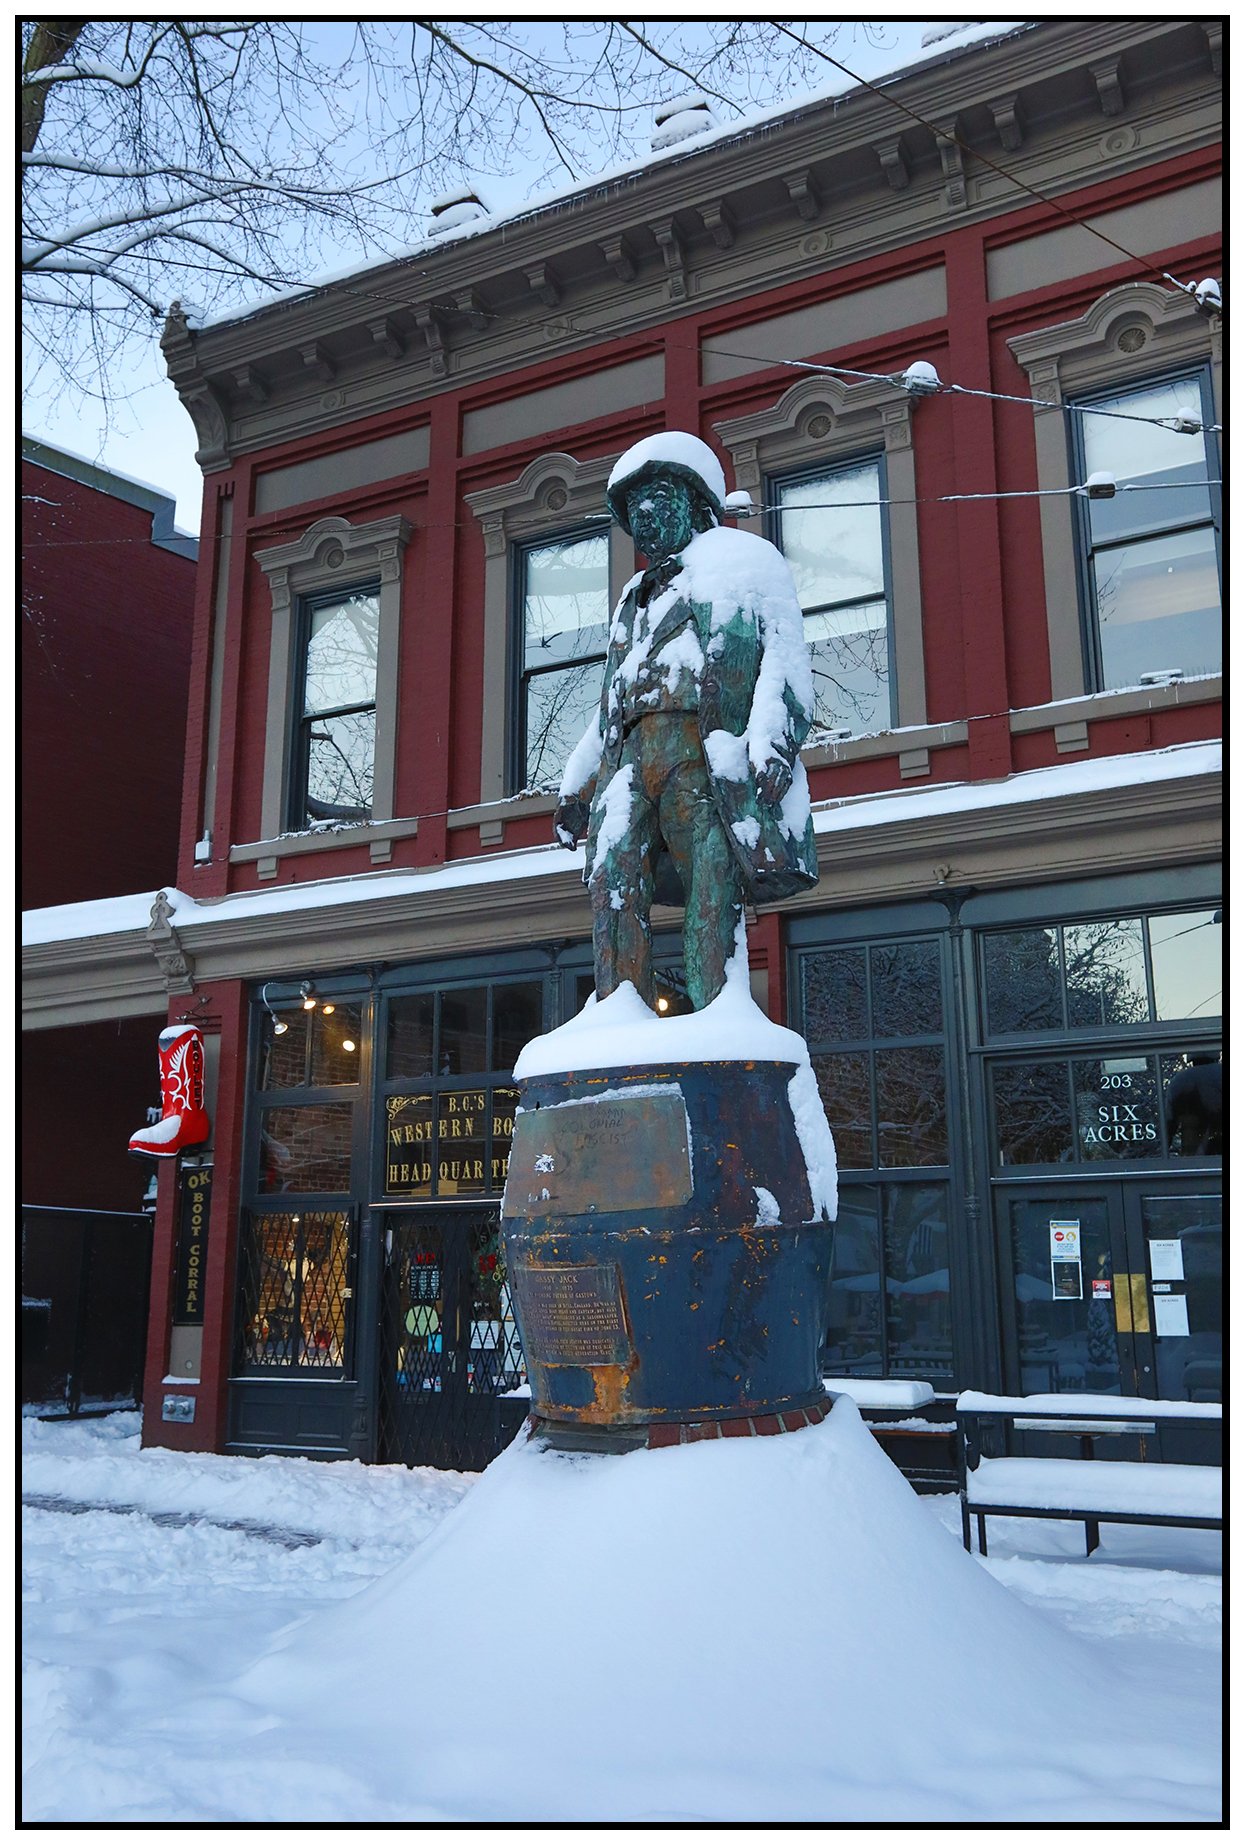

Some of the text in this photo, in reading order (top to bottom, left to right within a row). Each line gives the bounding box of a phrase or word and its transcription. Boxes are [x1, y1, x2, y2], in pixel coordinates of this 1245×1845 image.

[1100, 1074, 1132, 1089] 203
[1098, 1104, 1139, 1122] SIX
[390, 1117, 513, 1148] WESTERN BO
[1084, 1123, 1157, 1143] ACRES
[188, 1170, 211, 1189] OK
[191, 1192, 204, 1237] BOOT
[186, 1244, 200, 1313] CORRAL
